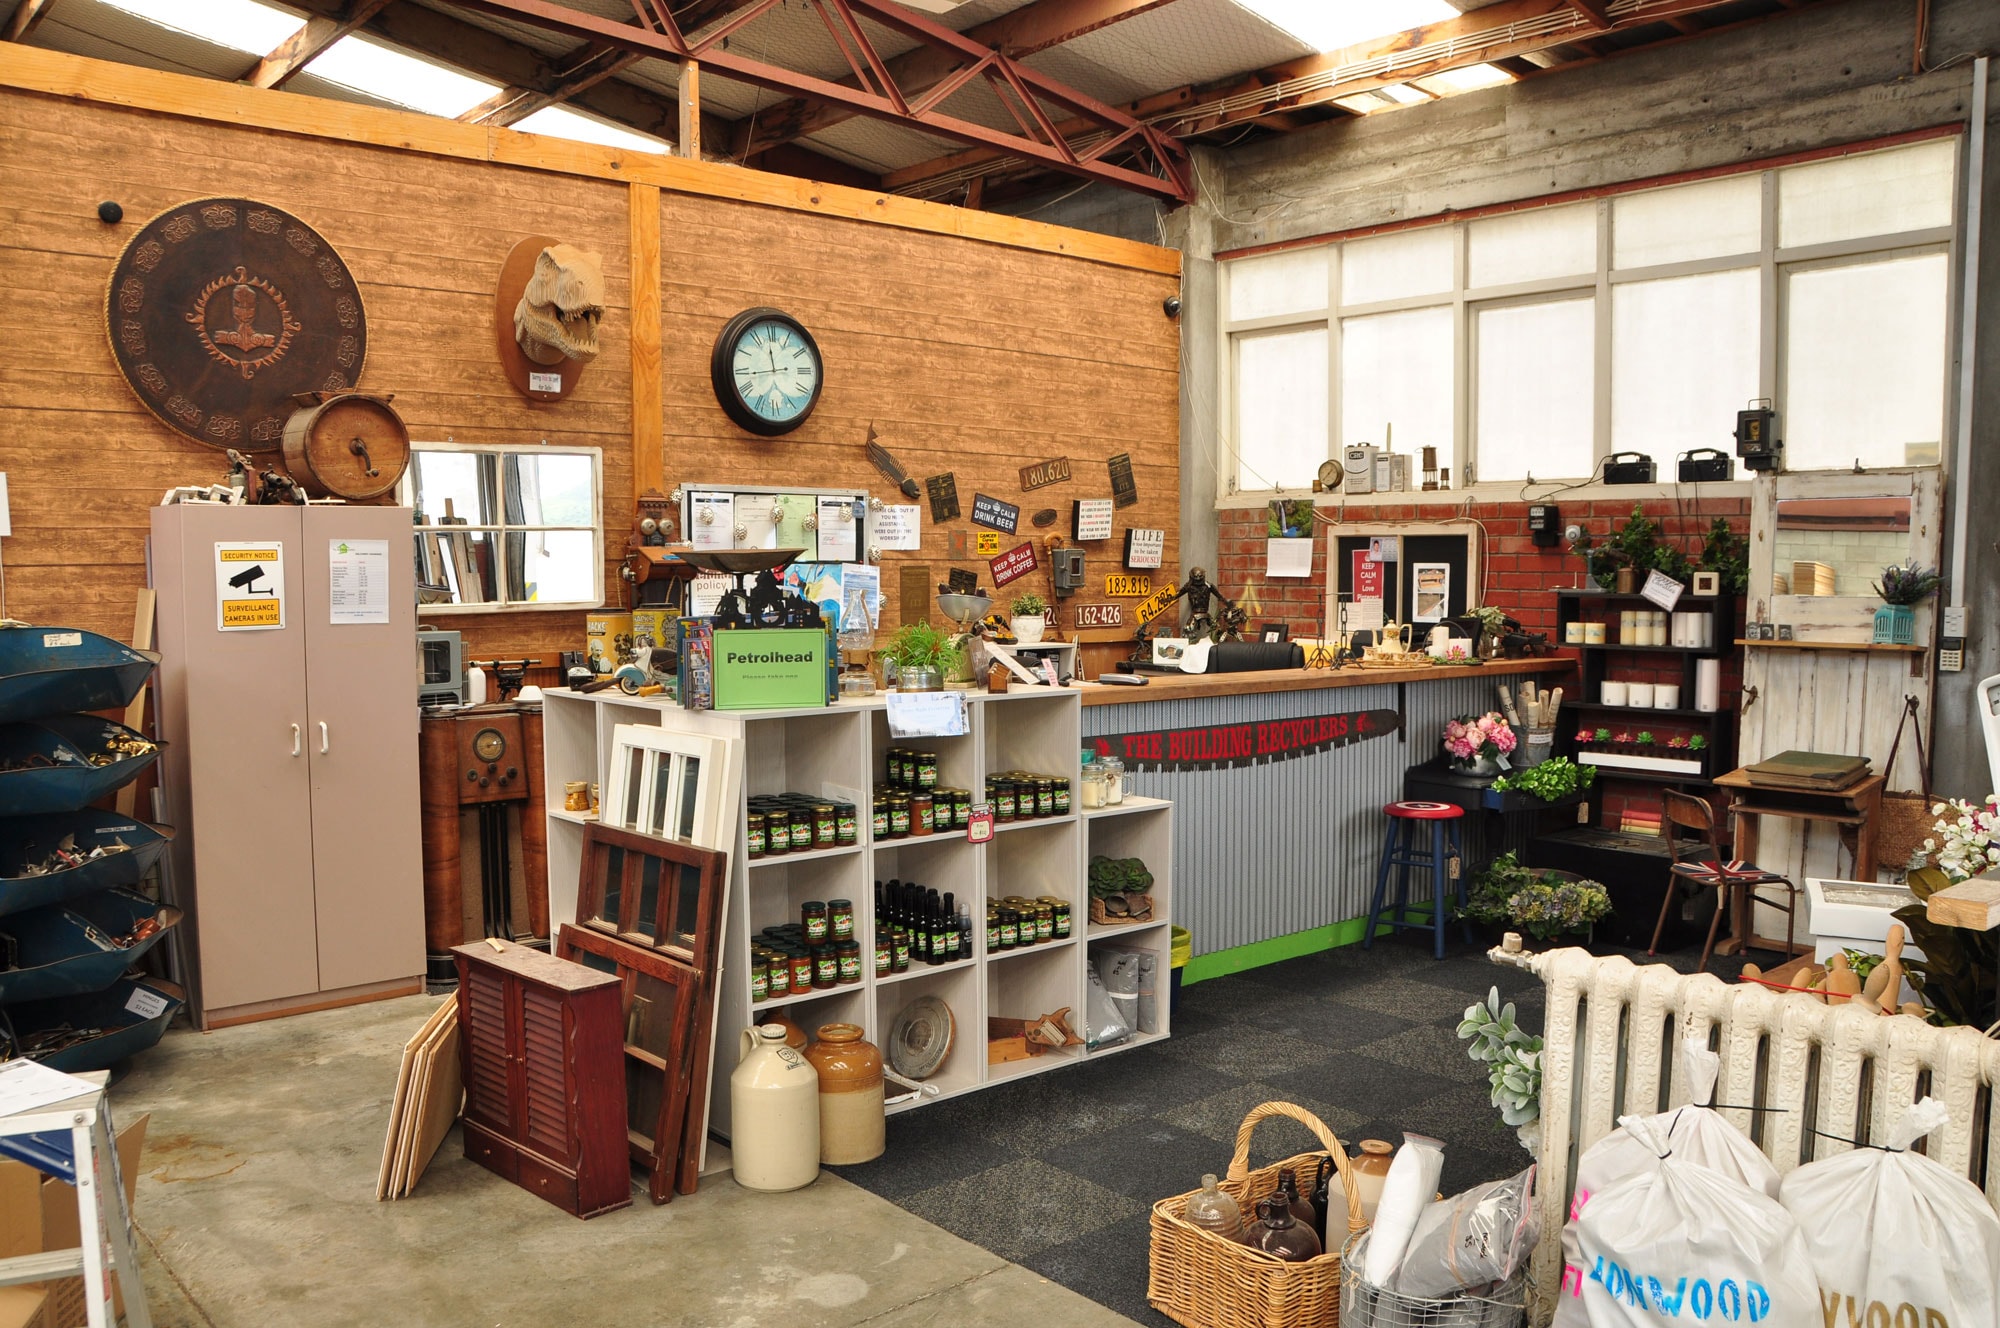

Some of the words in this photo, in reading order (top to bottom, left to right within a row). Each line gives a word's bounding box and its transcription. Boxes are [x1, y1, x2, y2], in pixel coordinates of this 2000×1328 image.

[1023, 459, 1070, 488] 180.620
[976, 501, 991, 511] KEEP
[1000, 509, 1015, 519] CALM
[974, 510, 996, 524] DRINK
[996, 517, 1014, 529] BEER
[1134, 530, 1162, 542] LIFE
[993, 561, 1008, 572] KEEP
[1016, 549, 1031, 561] CALM
[1130, 556, 1161, 564] SERIOUSLY
[996, 569, 1013, 583] DRINK
[1013, 558, 1034, 574] COFFEE
[696, 580, 727, 591] policy
[1108, 577, 1149, 593] 189.819
[228, 604, 274, 612] SURVEILLANCE
[727, 651, 813, 664] Petrolhead
[1122, 733, 1163, 760] THE
[1168, 725, 1253, 760] BUILDING
[1257, 715, 1348, 754] RECYCLERS
